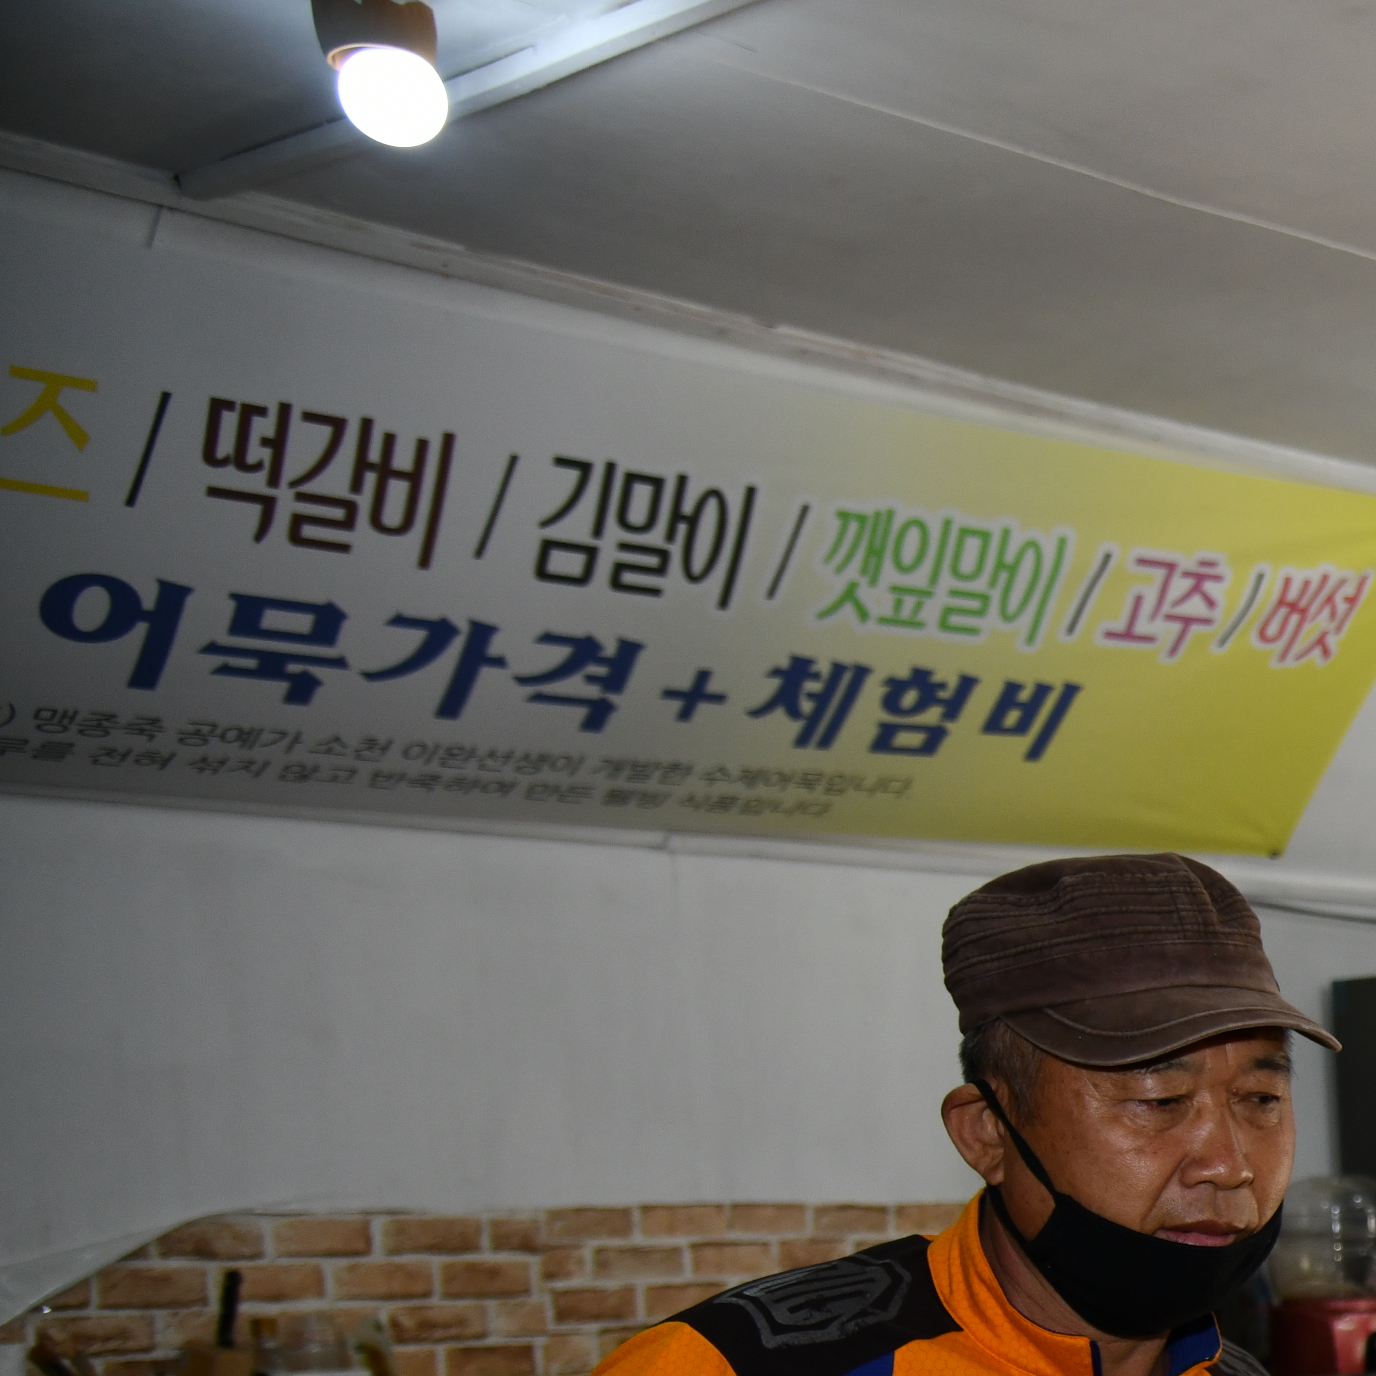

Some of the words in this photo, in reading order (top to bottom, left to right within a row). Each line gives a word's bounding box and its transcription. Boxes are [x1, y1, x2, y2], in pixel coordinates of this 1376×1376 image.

[0, 365, 97, 501] 즈
[200, 396, 455, 570] 떡갈비
[534, 455, 757, 610] 김말이
[39, 572, 645, 734] 어묵가격
[746, 655, 1083, 762] 체험비
[32, 705, 165, 743] 맹종죽
[176, 718, 302, 754] 공예가
[306, 734, 394, 763] 소천
[88, 745, 177, 772] 전혀
